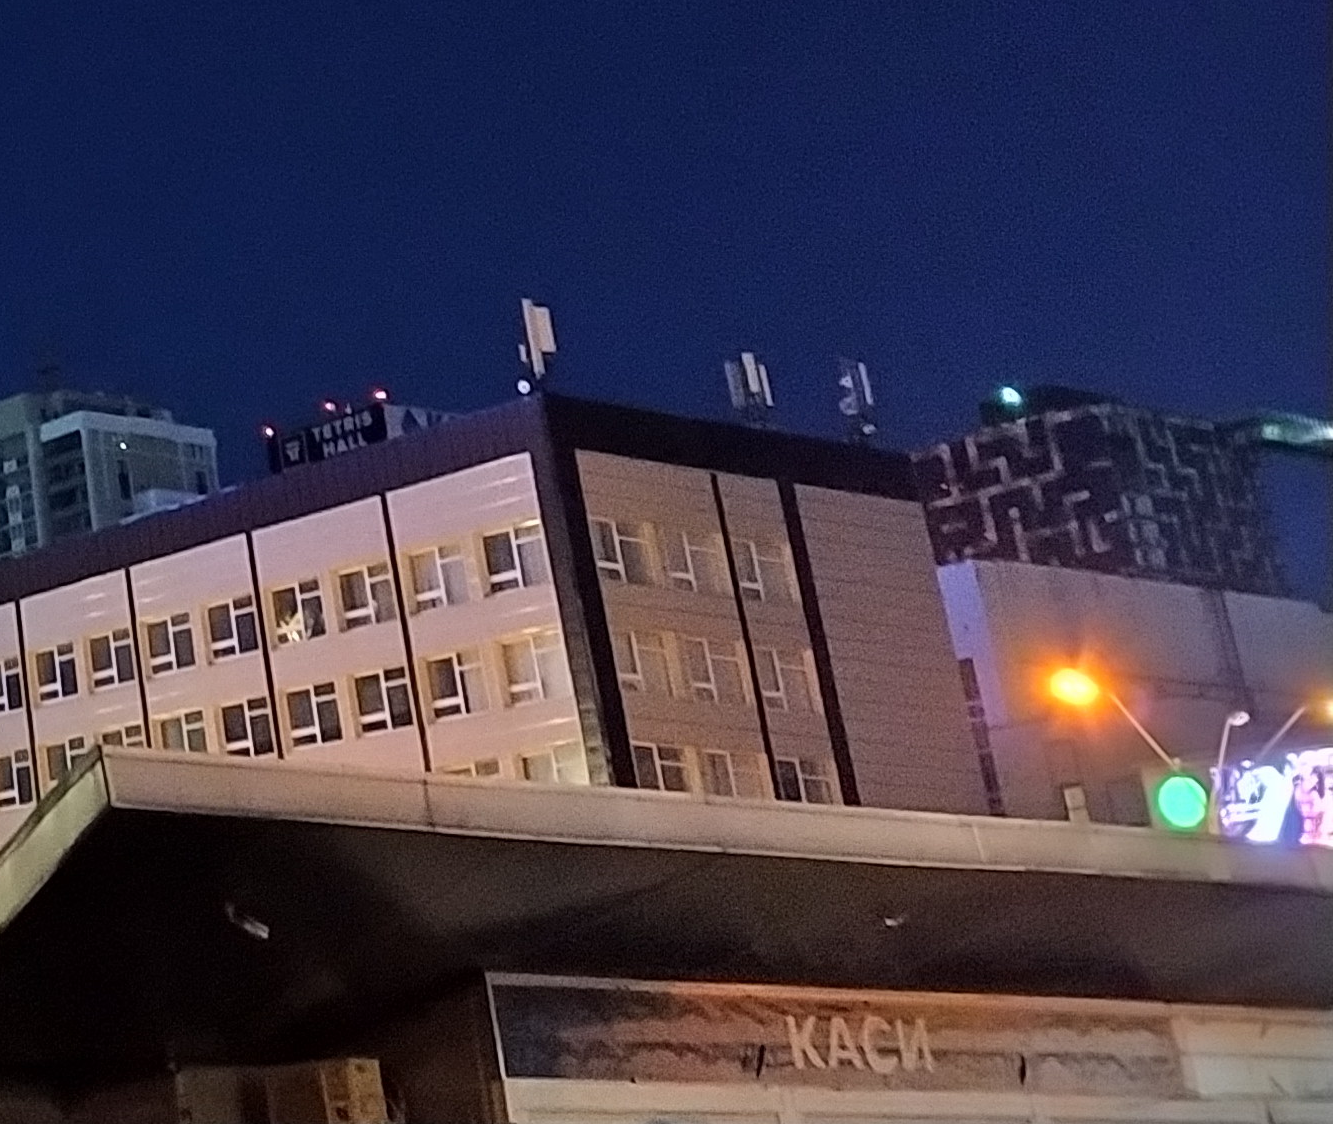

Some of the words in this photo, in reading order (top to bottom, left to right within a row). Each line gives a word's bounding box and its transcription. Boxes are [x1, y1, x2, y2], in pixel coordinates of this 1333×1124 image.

[311, 410, 373, 443] TETRIS
[322, 431, 367, 458] HALL
[785, 1014, 934, 1074] КАСИ
